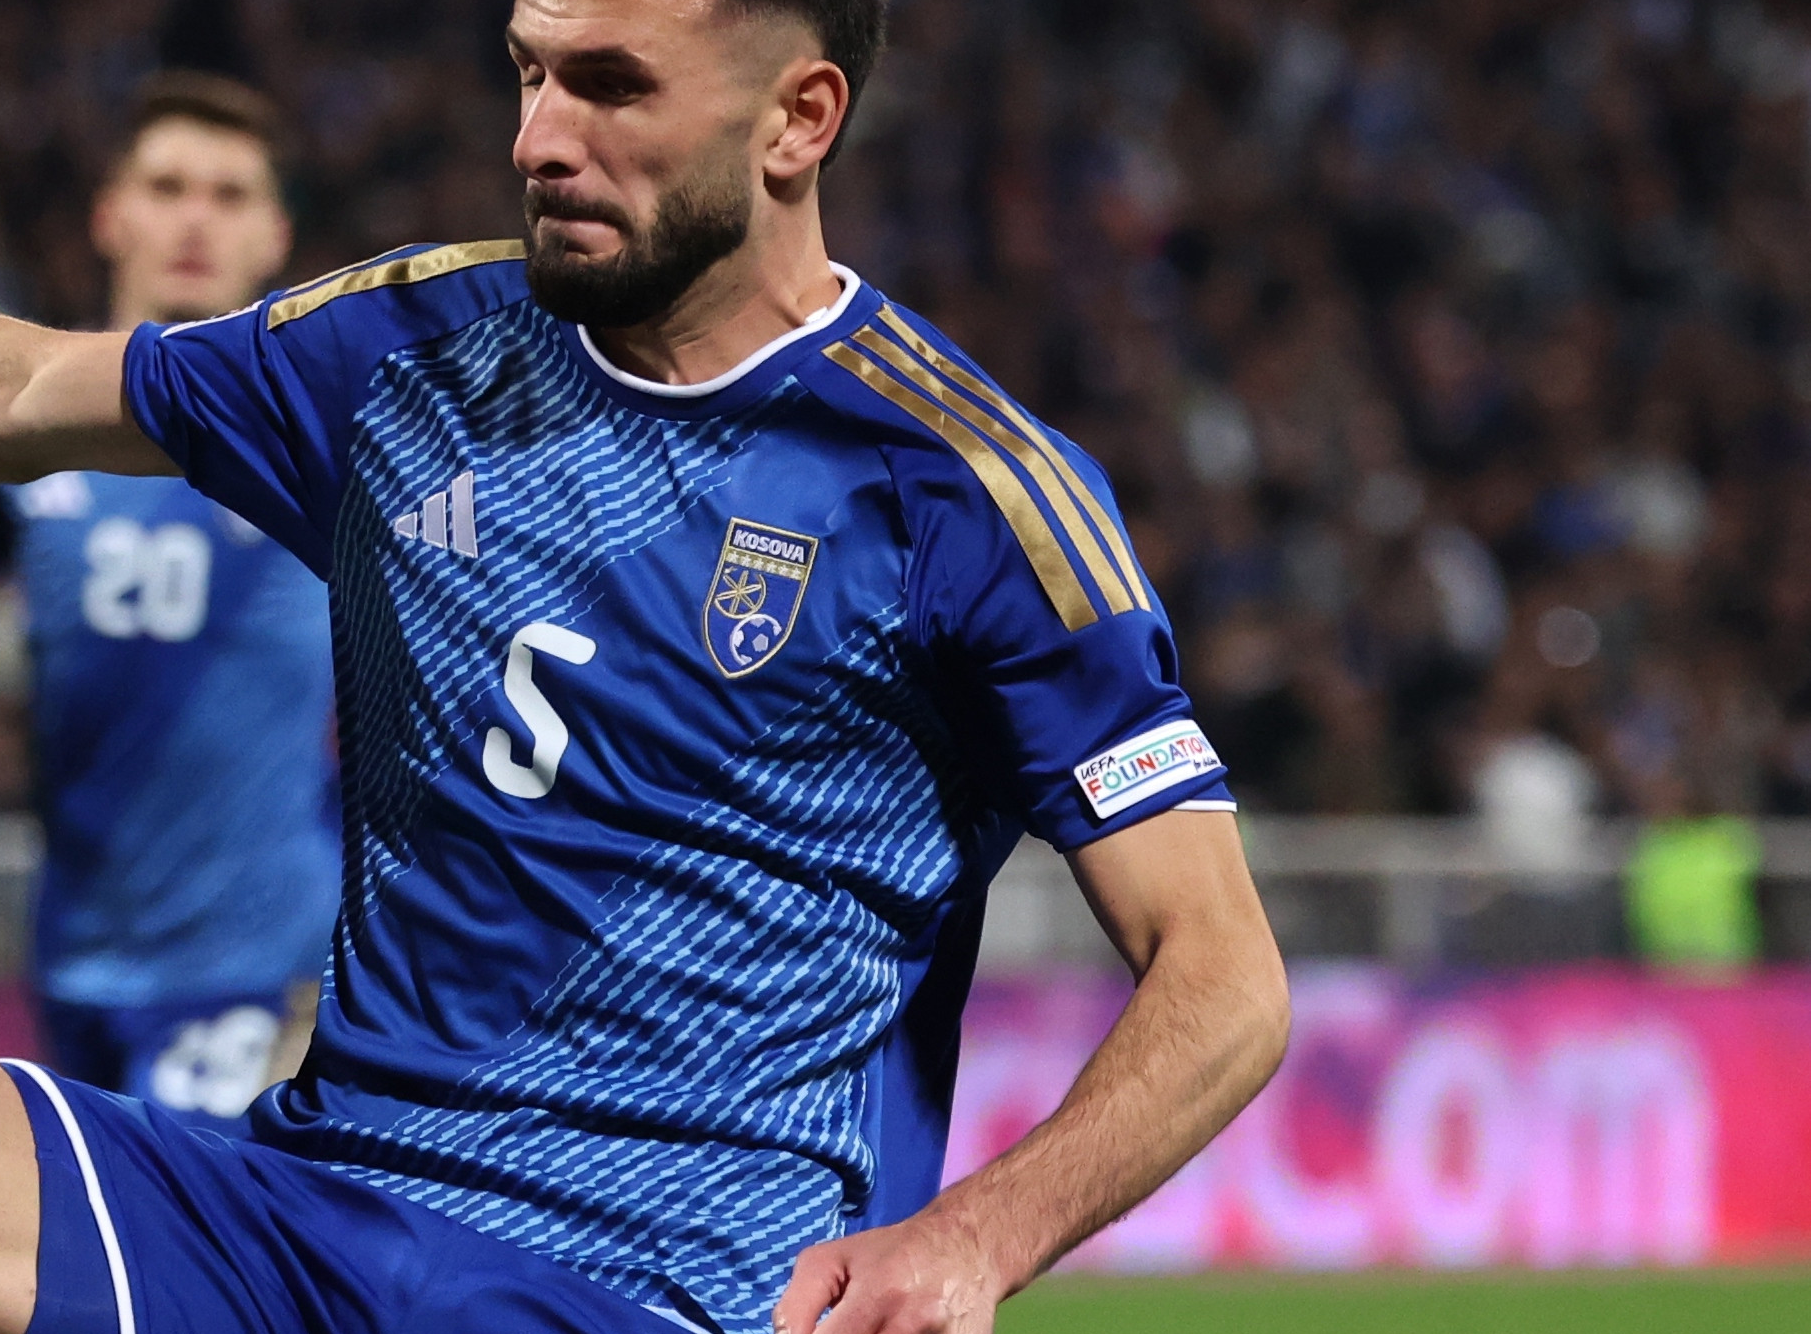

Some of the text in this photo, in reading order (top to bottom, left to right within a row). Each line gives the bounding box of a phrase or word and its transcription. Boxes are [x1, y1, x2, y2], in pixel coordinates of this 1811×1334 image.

[733, 528, 806, 564] KOSOVA
[81, 515, 214, 643] 20
[482, 622, 597, 799] 5
[1081, 755, 1117, 780] UEFA
[1086, 736, 1212, 799] FOUNDATION
